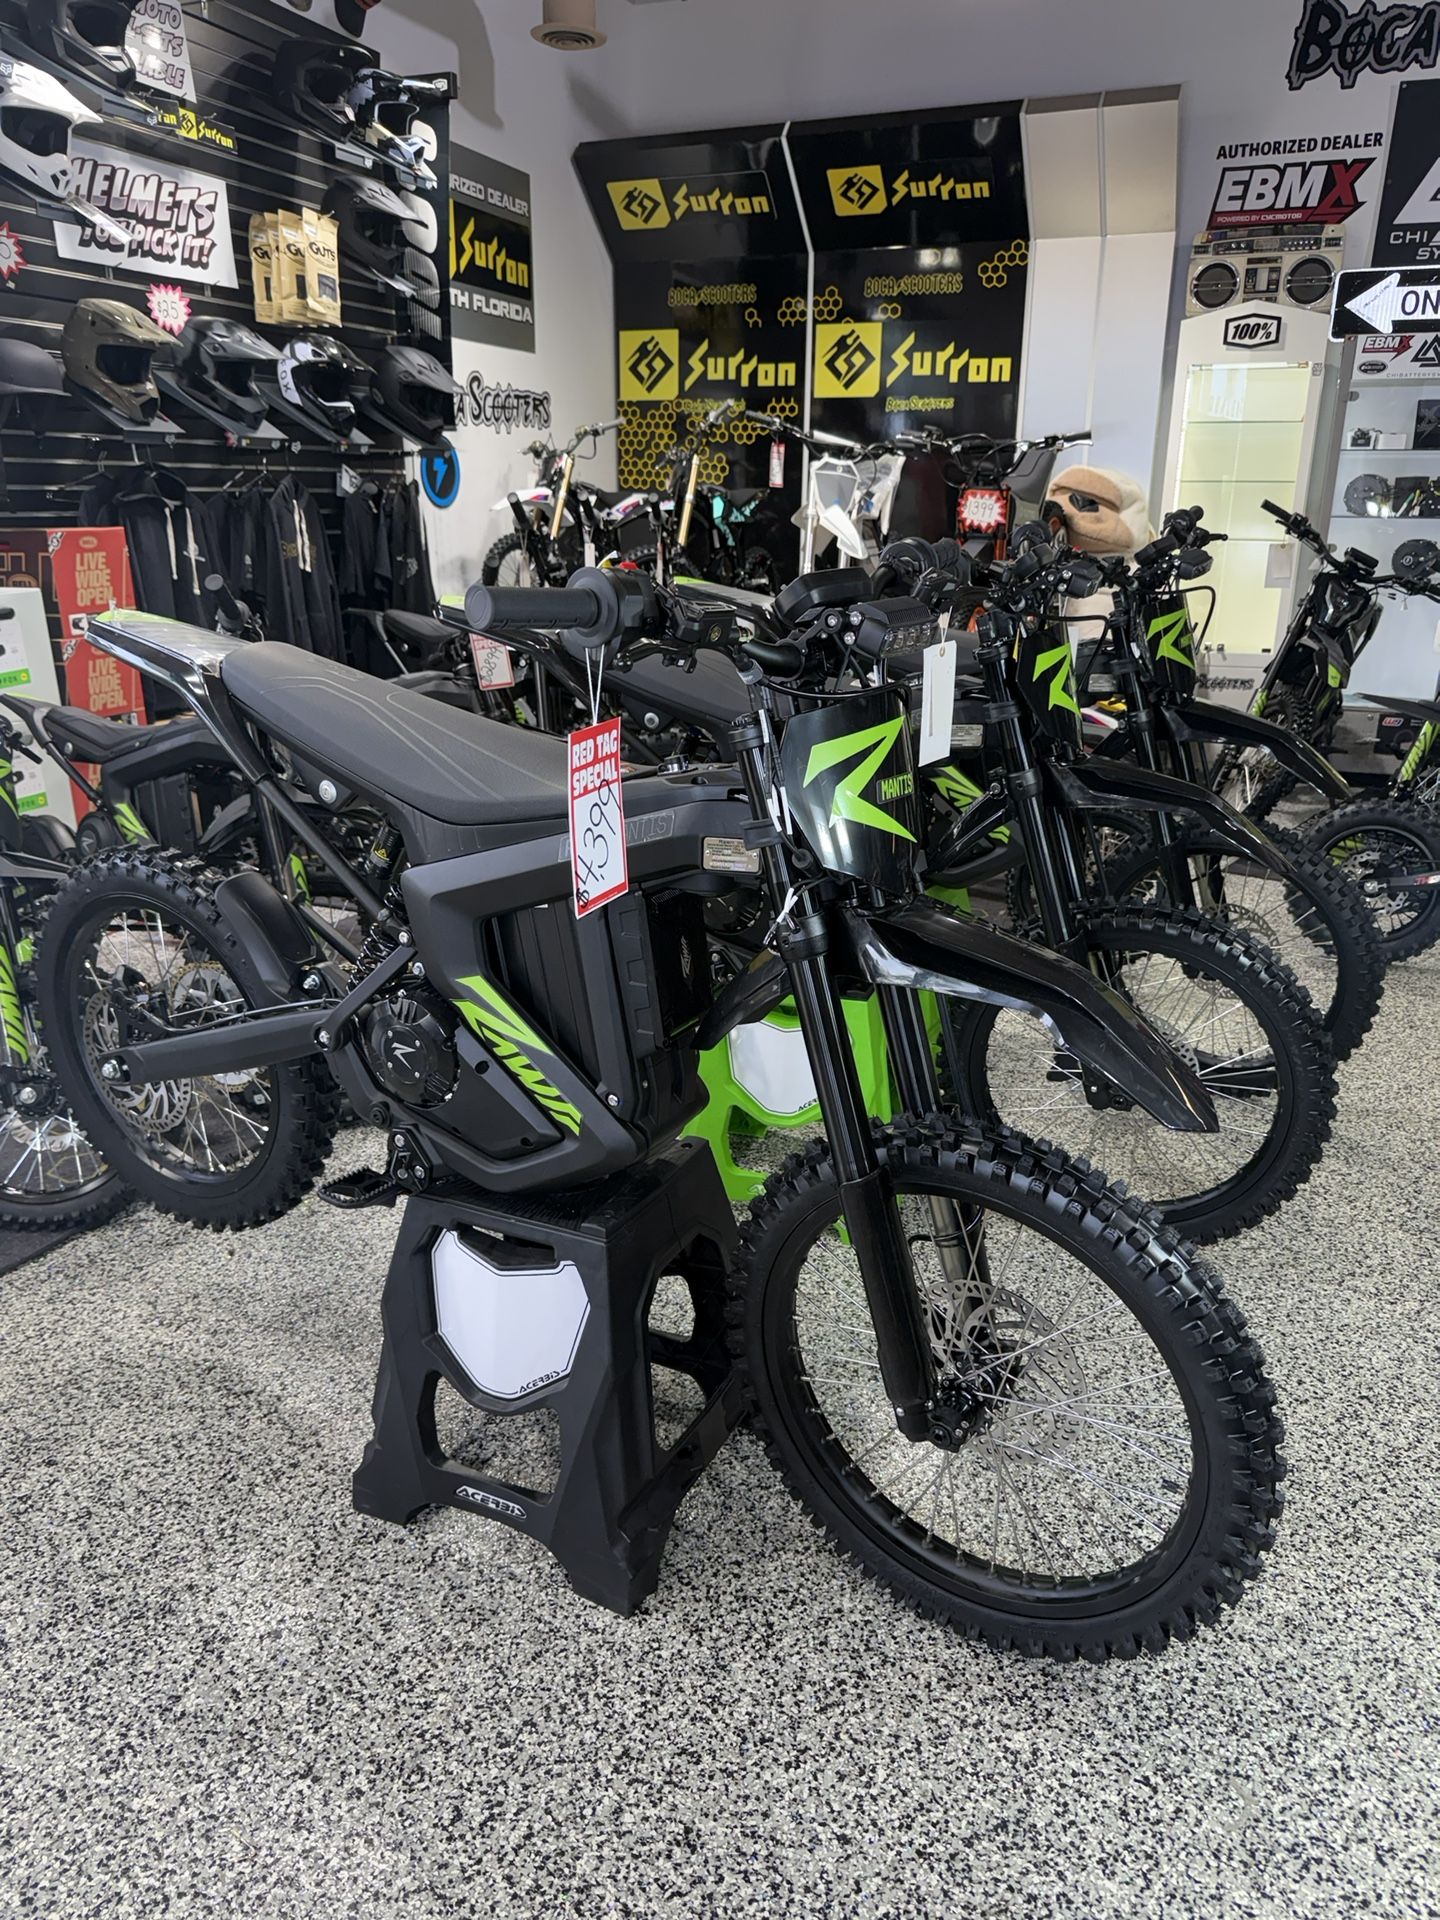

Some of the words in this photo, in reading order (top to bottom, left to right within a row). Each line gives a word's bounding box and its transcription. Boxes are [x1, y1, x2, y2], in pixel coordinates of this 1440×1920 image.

[1286, 0, 1440, 91] BOCA
[1216, 136, 1318, 161] AUTHORIZED
[1320, 132, 1384, 152] DEALER
[72, 157, 218, 237] HELMETS
[892, 169, 990, 207] Surron
[1214, 161, 1370, 212] EBMX
[487, 188, 529, 217] DEALER
[672, 183, 770, 221] Surron
[128, 223, 179, 263] PICK
[181, 233, 215, 270] IT!
[309, 241, 336, 262] GUTS
[459, 216, 529, 288] Surron
[668, 287, 700, 307] BOCA
[700, 283, 757, 306] SCOOTERS
[864, 276, 897, 298] BOCA
[900, 273, 963, 296] SCOOTERS
[473, 293, 533, 325] FLORIDA
[1231, 321, 1274, 341] 100%
[1364, 334, 1412, 349] EBMX
[684, 338, 796, 392] Surron
[886, 331, 1012, 388] Surron
[466, 370, 551, 434] SCOOTERS
[75, 552, 107, 571] LIVE
[75, 569, 111, 589] WIDE
[88, 659, 117, 678] LIVE
[88, 673, 121, 696] WIDE
[572, 743, 594, 769] RED
[596, 729, 618, 755] TAG
[573, 757, 618, 797] SPECIAL
[881, 774, 913, 800] MANTIS
[519, 1370, 561, 1393] ACERBIS
[458, 1488, 526, 1518] ACERBIS
